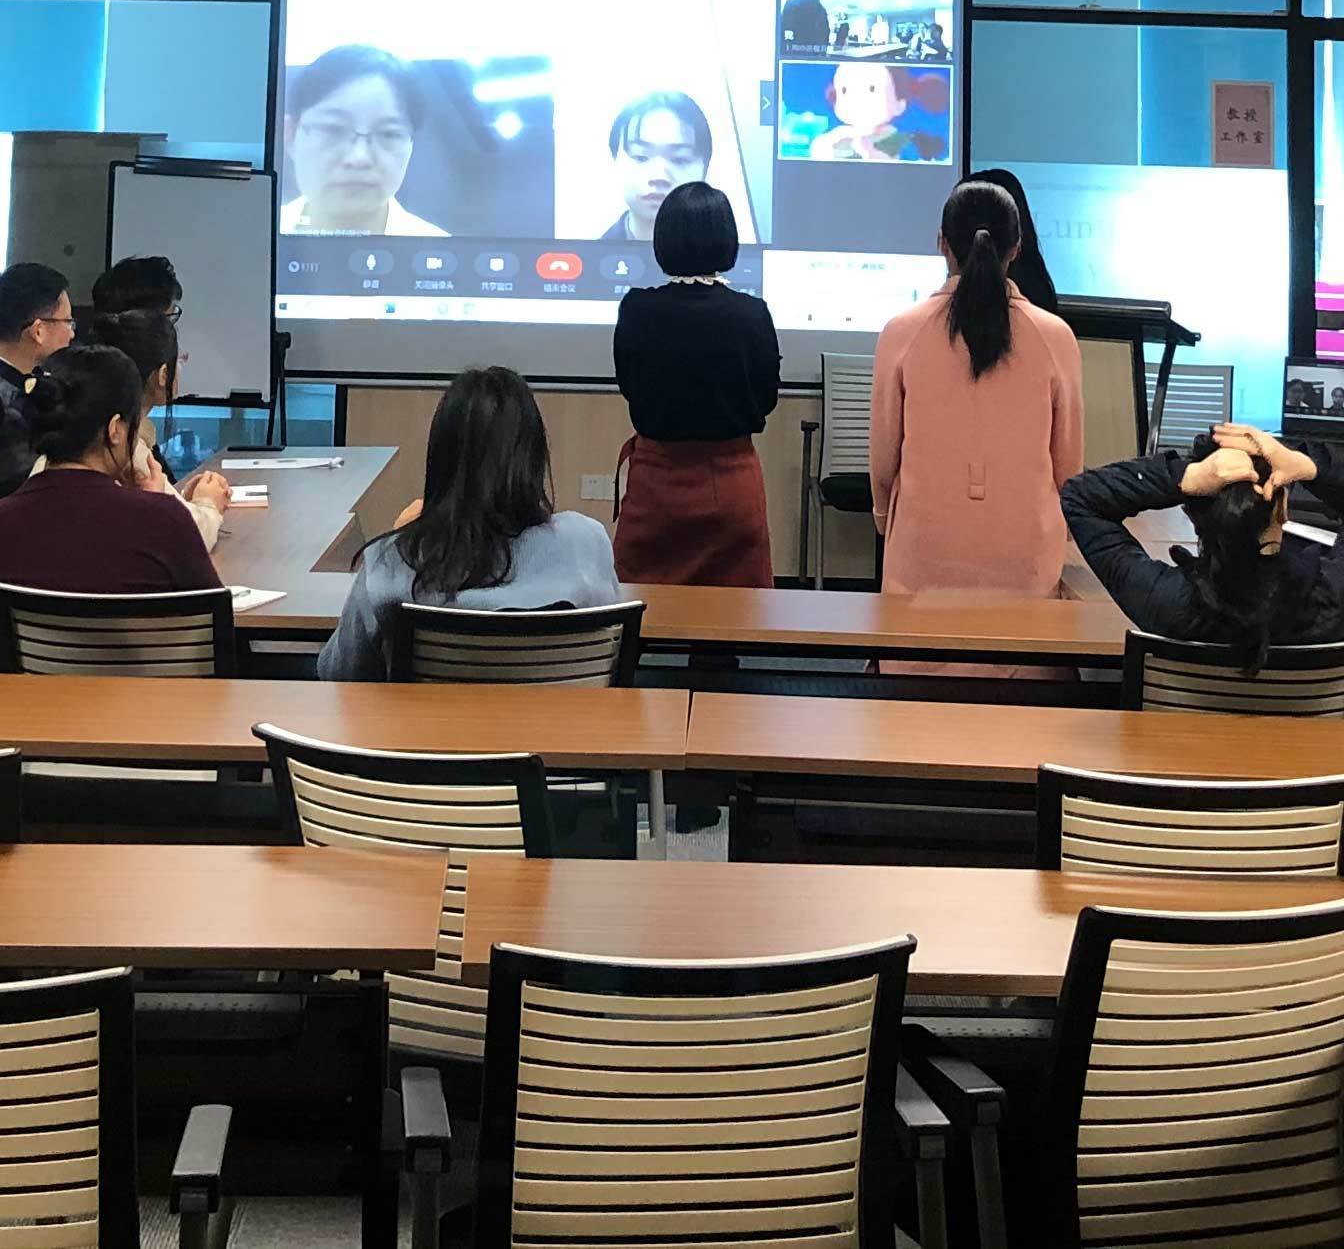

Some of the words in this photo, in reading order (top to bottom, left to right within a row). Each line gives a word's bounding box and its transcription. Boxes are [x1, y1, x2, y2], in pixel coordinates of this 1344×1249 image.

[1226, 107, 1258, 123] 教授
[1220, 130, 1265, 144] 工作室
